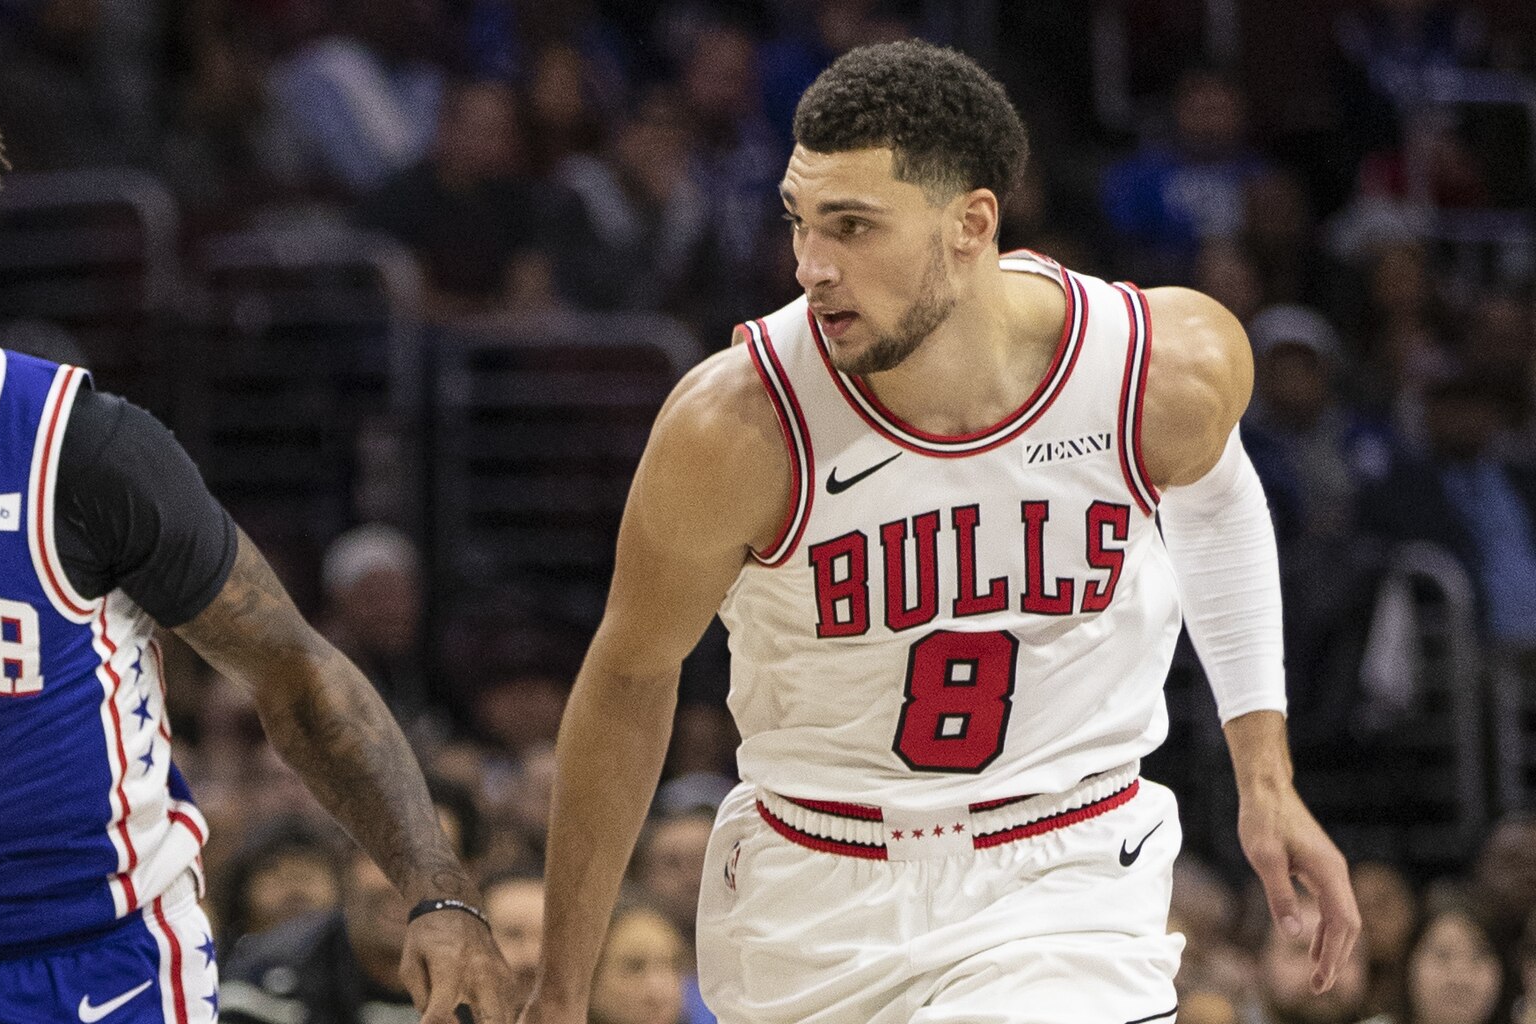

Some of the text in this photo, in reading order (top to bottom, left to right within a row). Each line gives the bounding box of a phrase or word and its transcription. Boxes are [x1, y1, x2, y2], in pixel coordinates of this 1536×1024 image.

[1026, 433, 1111, 464] ZENNI
[808, 500, 1131, 639] BULLS
[891, 629, 1020, 774] 8
